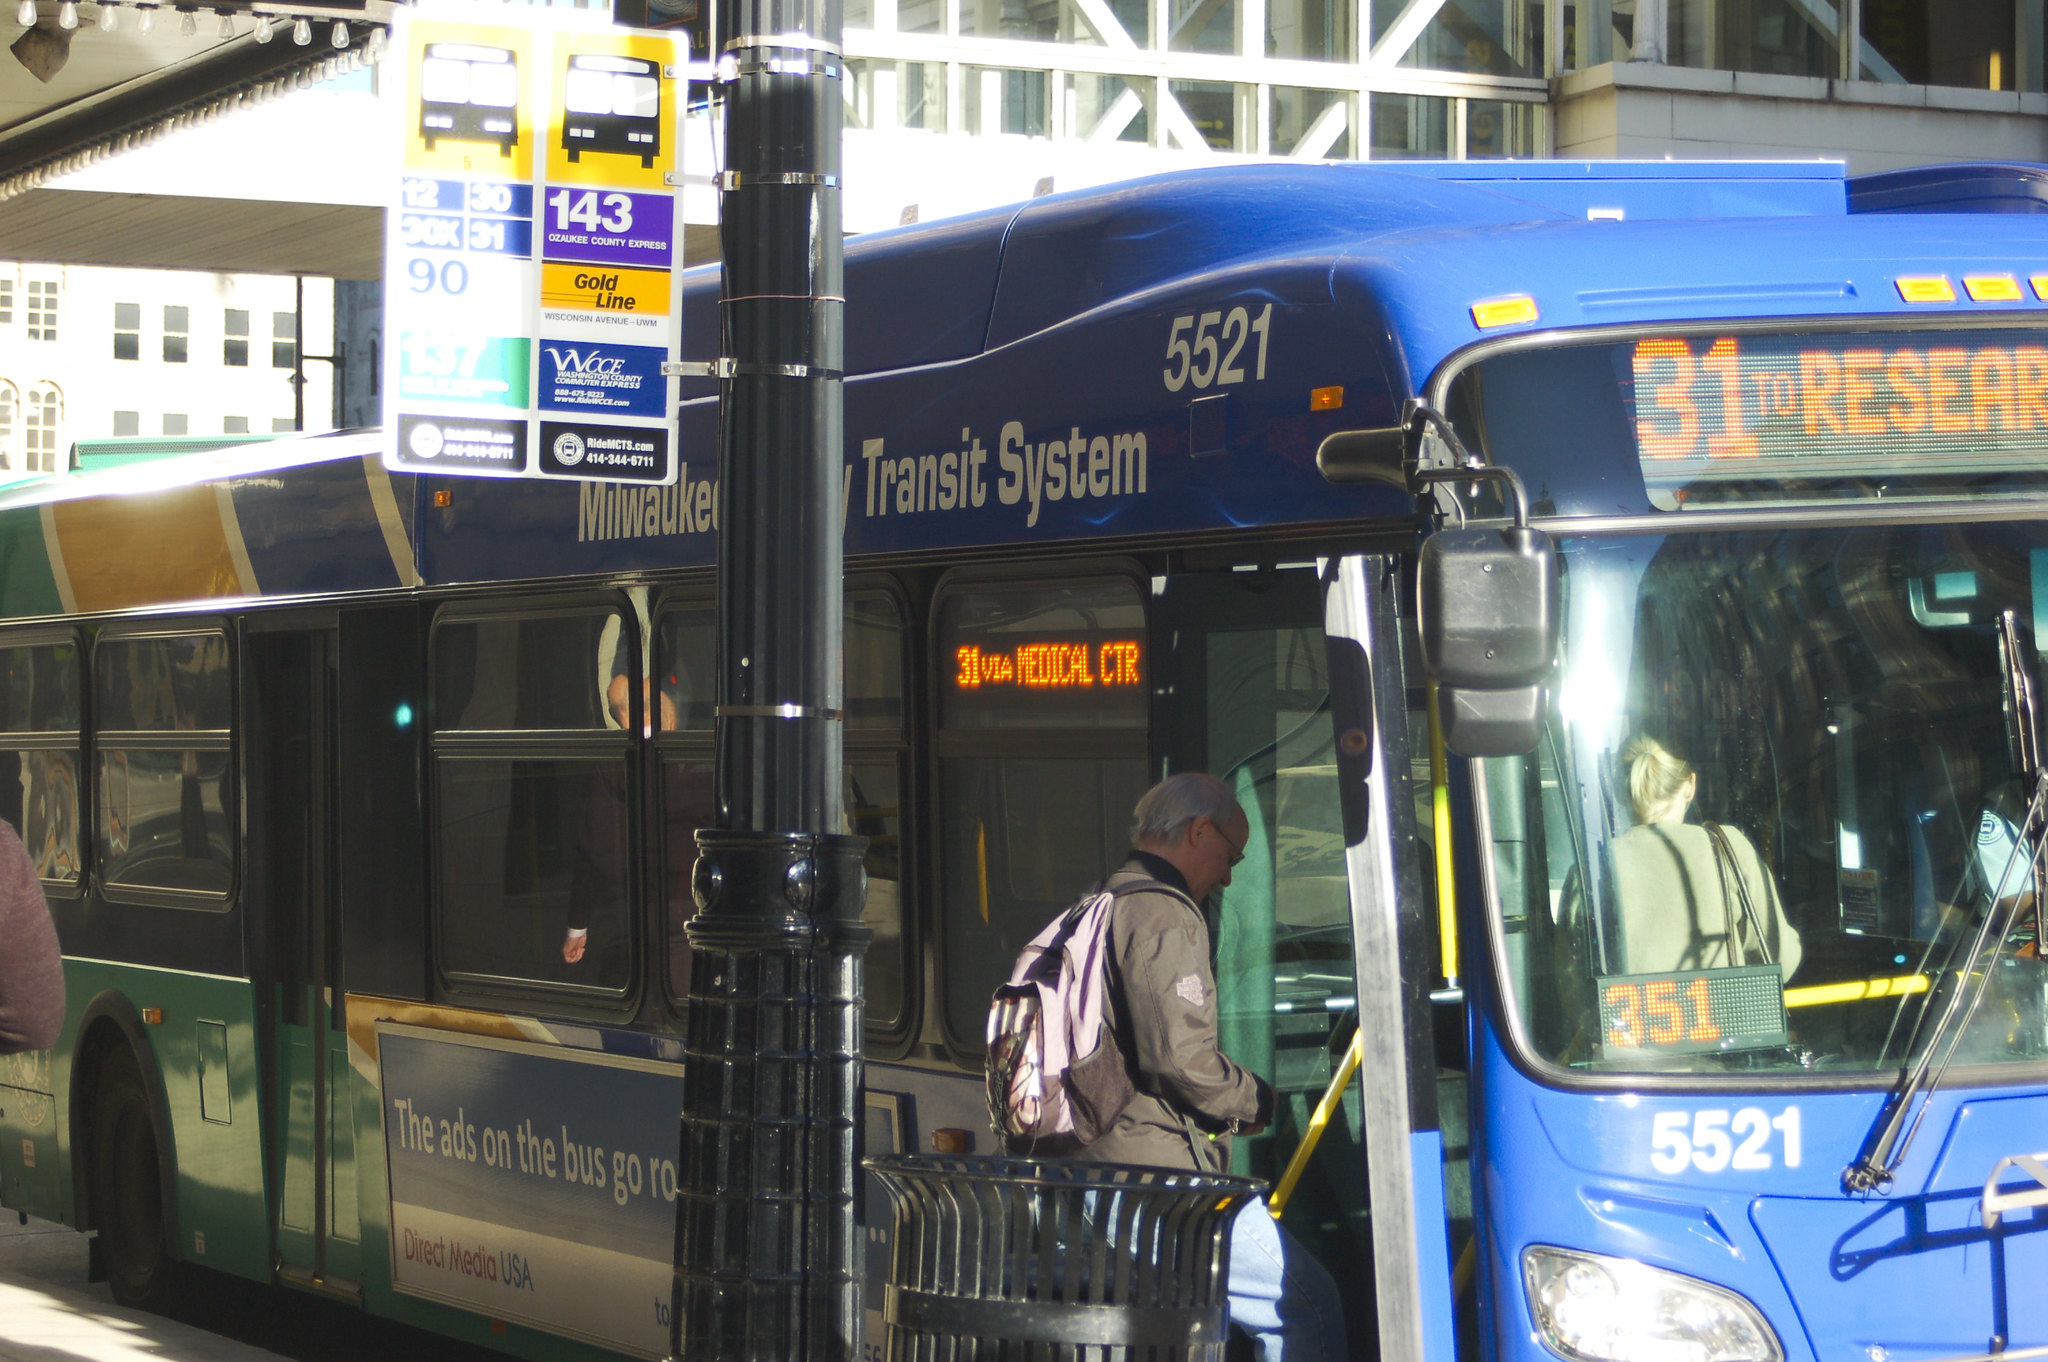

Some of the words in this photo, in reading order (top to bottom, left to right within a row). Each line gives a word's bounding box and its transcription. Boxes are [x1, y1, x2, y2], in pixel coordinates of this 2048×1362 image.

[403, 179, 439, 208] 12
[471, 183, 512, 212] 30
[549, 189, 633, 233] 143
[470, 221, 504, 250] 31
[548, 233, 588, 245] OZAUKEE
[591, 236, 626, 247] COUNTY
[628, 240, 667, 250] EXPRESS
[408, 258, 468, 295] 90
[574, 273, 619, 291] Gold
[595, 292, 636, 310] Line
[544, 312, 593, 323] WISCONSIN
[595, 315, 629, 325] AVENUE
[636, 318, 658, 327] UWM
[544, 348, 626, 375] WCCE
[1162, 303, 1273, 393] 5521
[554, 377, 600, 387] COMMUTER
[600, 380, 641, 390] EXPRESS
[557, 370, 609, 381] WASHINGTON
[610, 374, 643, 383] COUNTY
[554, 396, 630, 407] www.RideWCCE.com
[1631, 337, 1761, 459] 31
[1750, 370, 1797, 416] TO
[1800, 346, 2048, 436] RESEAR
[587, 437, 654, 452] RideMCTS.com
[862, 426, 987, 517] Transit
[998, 420, 1148, 529] System
[957, 645, 981, 686] 31
[981, 653, 1013, 681] VIA
[1016, 643, 1094, 686] MEDICAL
[1100, 641, 1140, 685] CTR
[1604, 976, 1721, 1048] 351
[394, 1097, 435, 1154] The
[439, 1106, 477, 1163] ads
[482, 1126, 512, 1169] on
[516, 1118, 557, 1178] the
[561, 1125, 607, 1189] bus
[612, 1150, 643, 1206] go
[649, 1157, 678, 1202] ro
[1650, 1104, 1802, 1176] 5521
[403, 1227, 446, 1270] Direct
[448, 1238, 498, 1283] Media
[500, 1250, 534, 1292] USA
